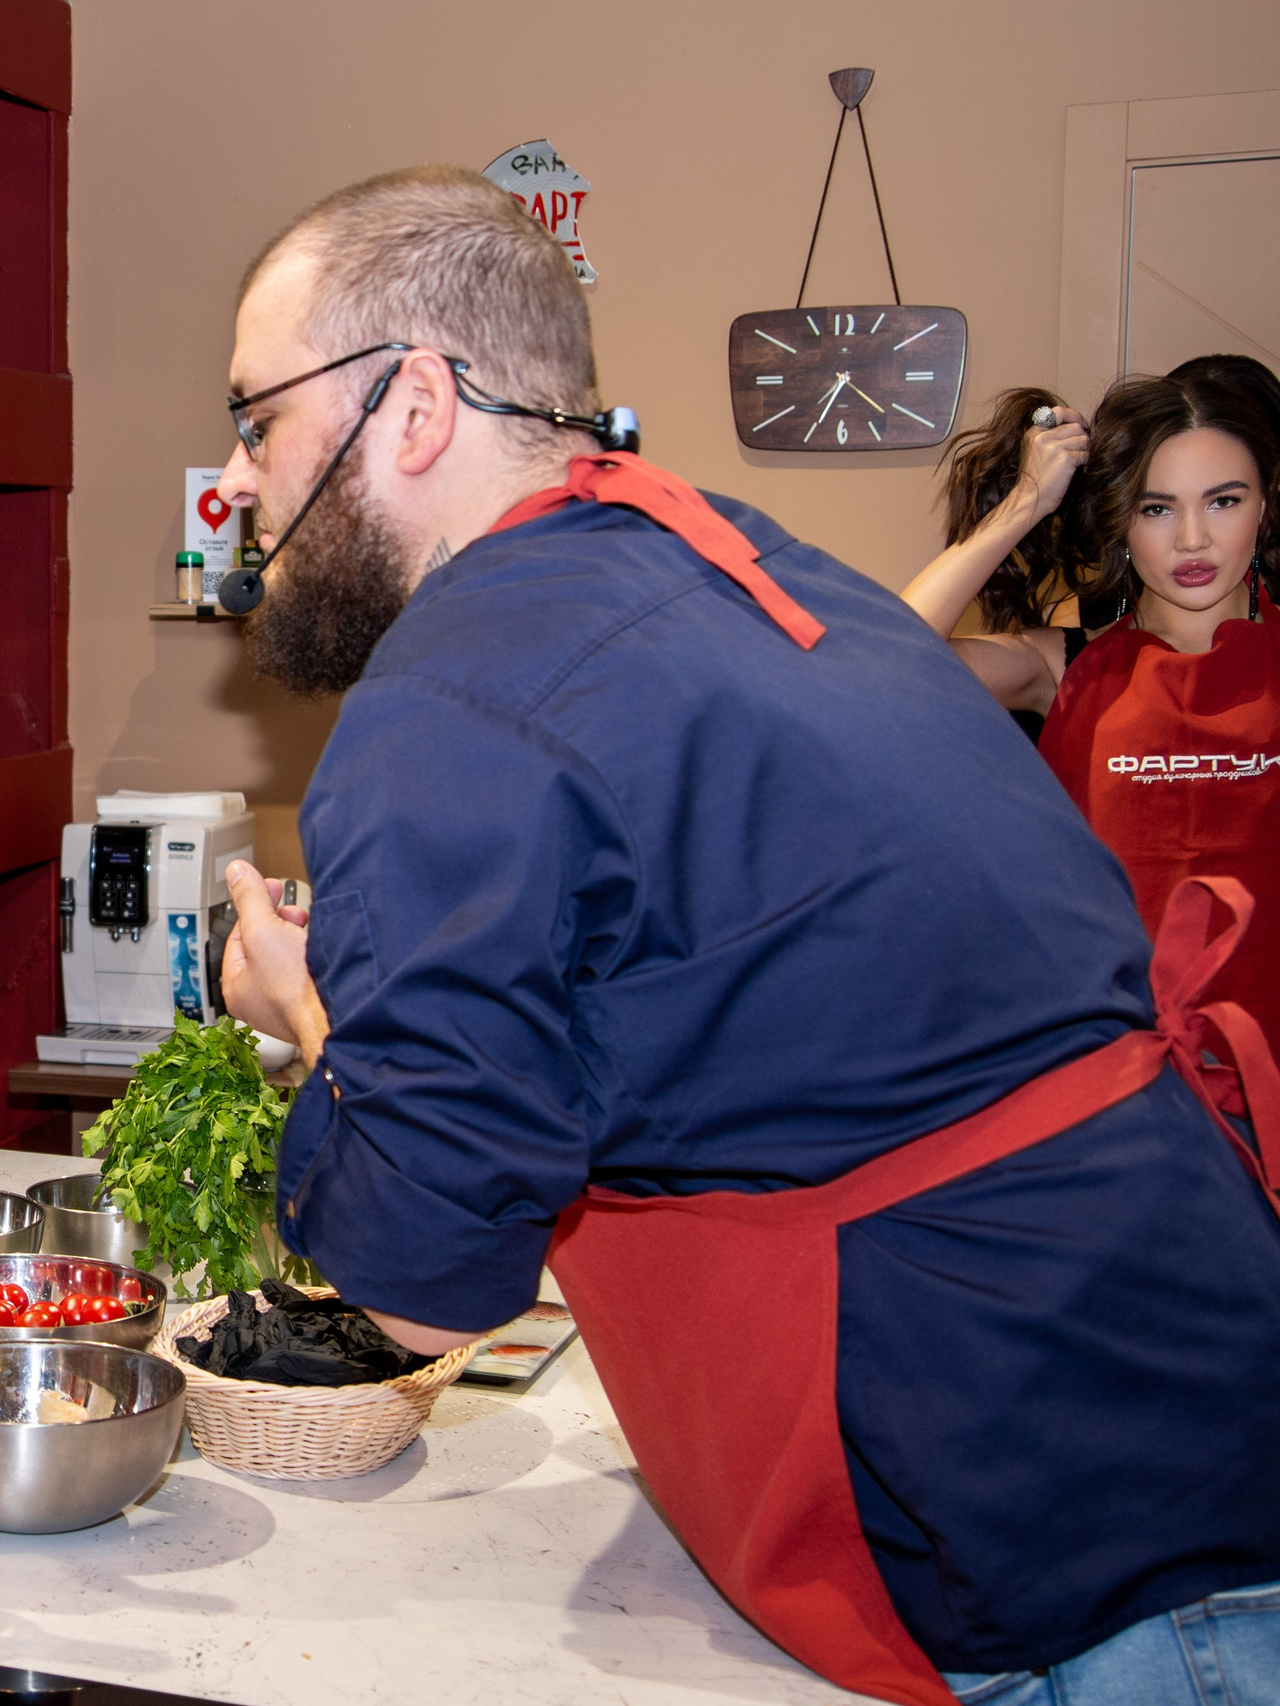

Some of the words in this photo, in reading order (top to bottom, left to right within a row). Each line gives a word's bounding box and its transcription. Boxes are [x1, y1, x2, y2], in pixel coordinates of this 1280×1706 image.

[834, 313, 855, 336] 12
[836, 419, 849, 445] 6
[1107, 753, 1280, 774] ФАРТУК
[1131, 774, 1163, 784] студия
